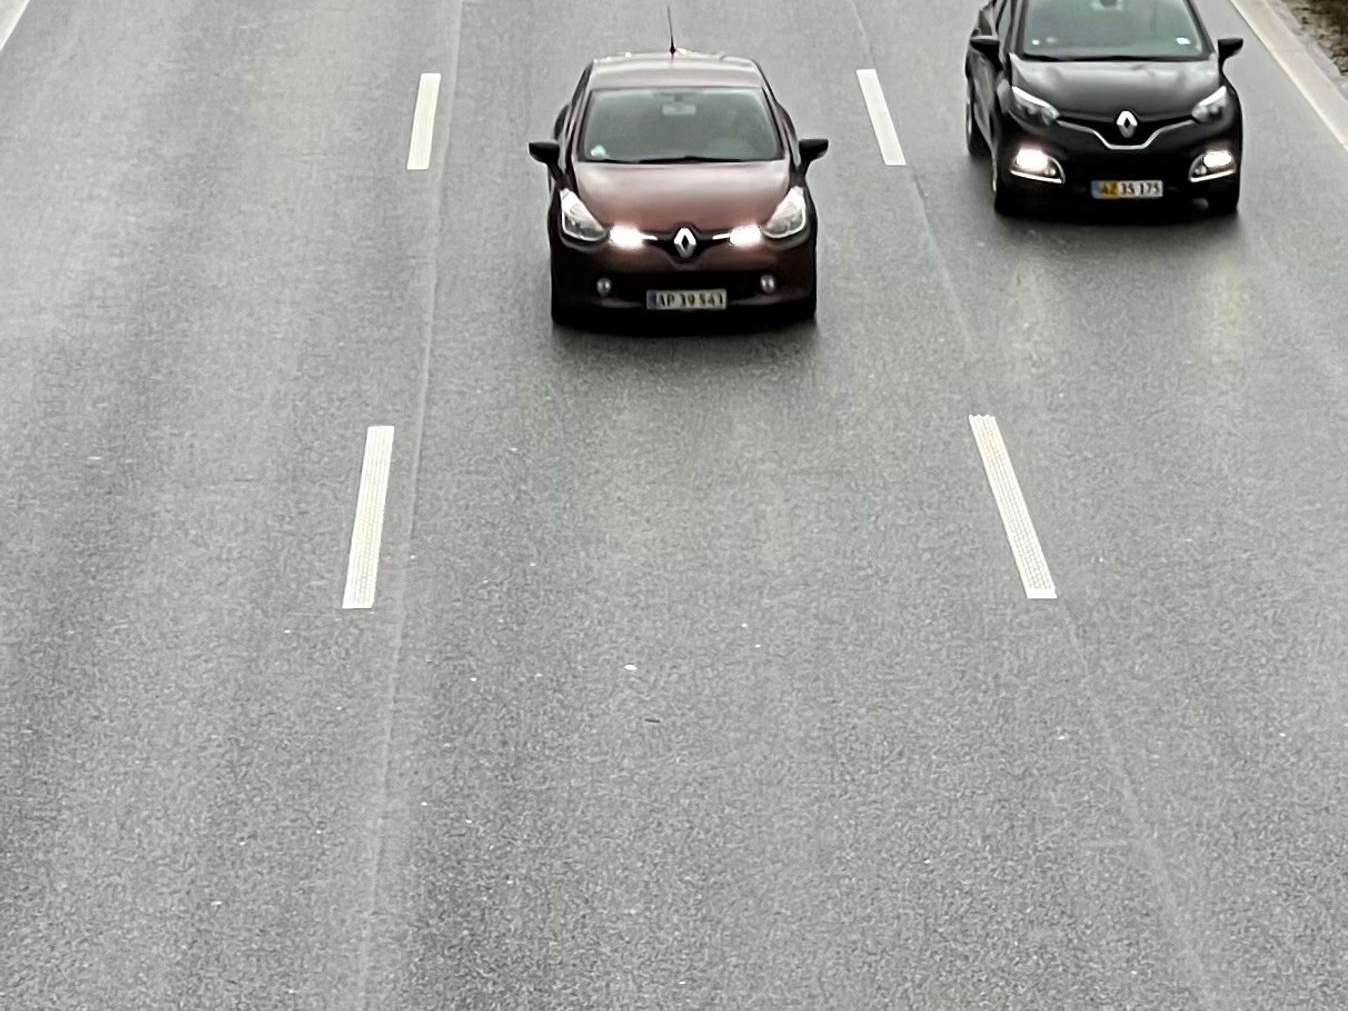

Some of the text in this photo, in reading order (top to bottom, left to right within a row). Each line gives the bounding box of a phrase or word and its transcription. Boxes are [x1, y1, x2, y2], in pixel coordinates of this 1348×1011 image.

[1121, 182, 1135, 195] 35
[1139, 182, 1160, 195] 175
[659, 293, 675, 307] AP
